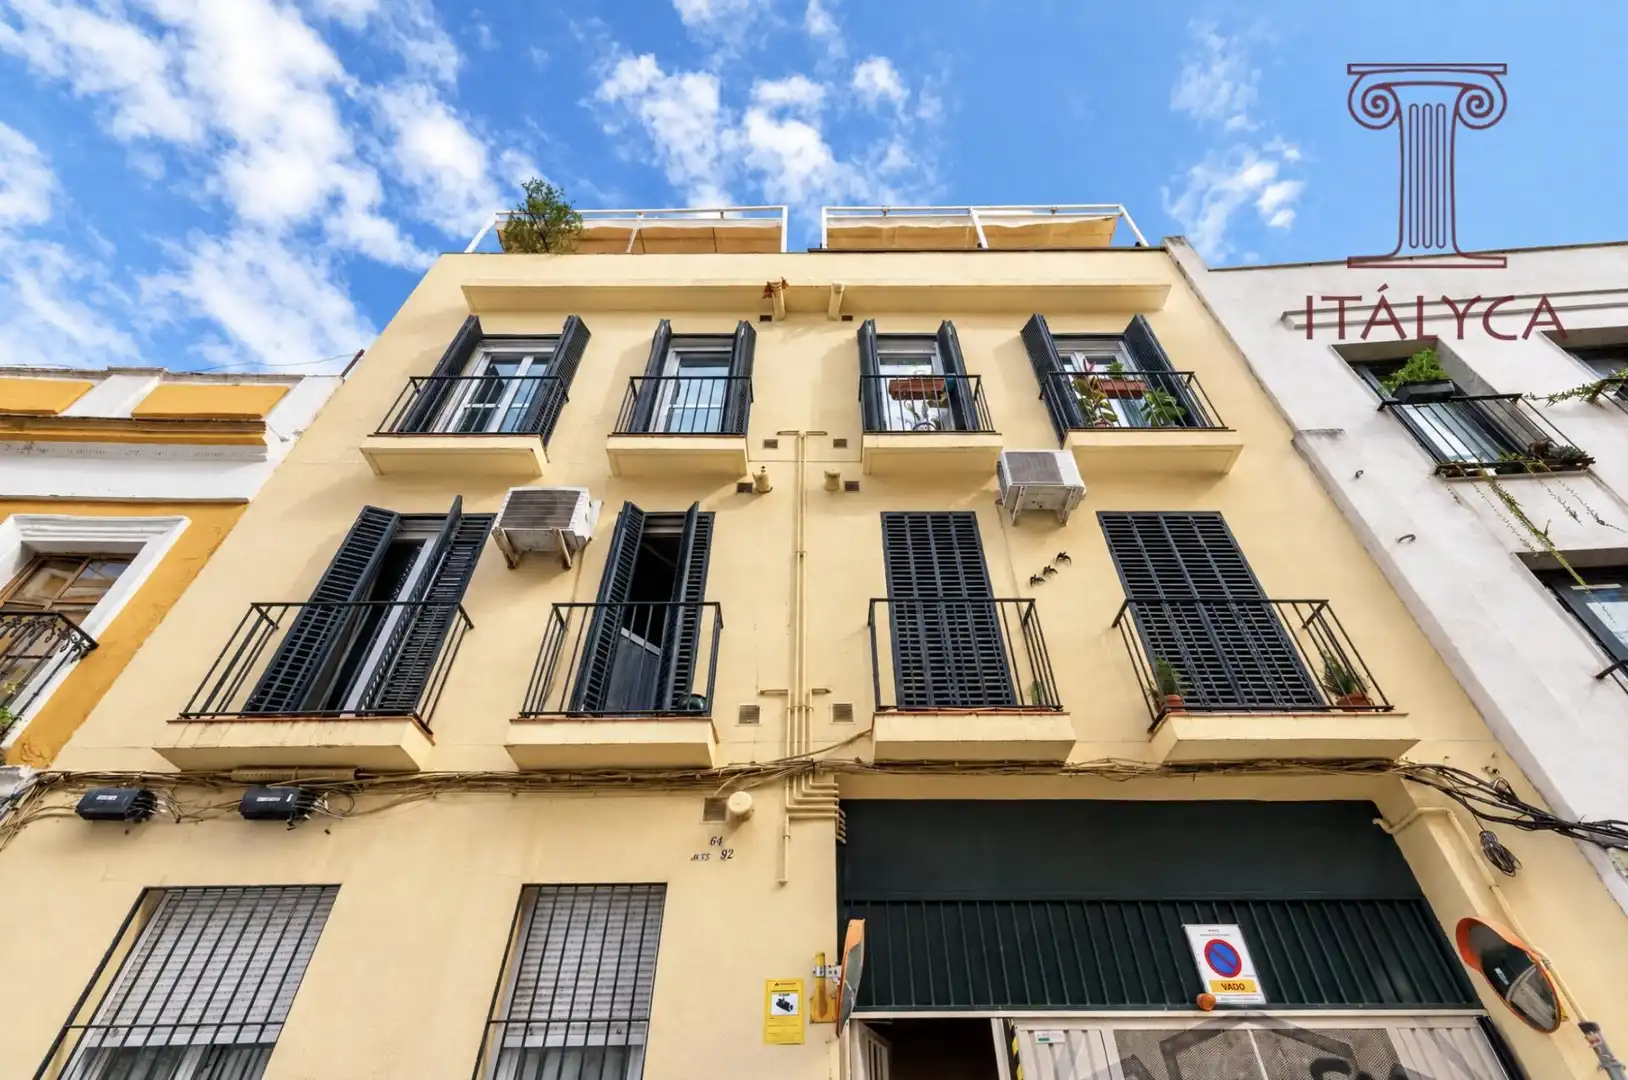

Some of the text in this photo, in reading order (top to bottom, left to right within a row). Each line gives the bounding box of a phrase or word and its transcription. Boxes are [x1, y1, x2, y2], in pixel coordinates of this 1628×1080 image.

[709, 836, 723, 846] 64
[720, 849, 734, 860] 92
[1220, 982, 1246, 991] VADO
